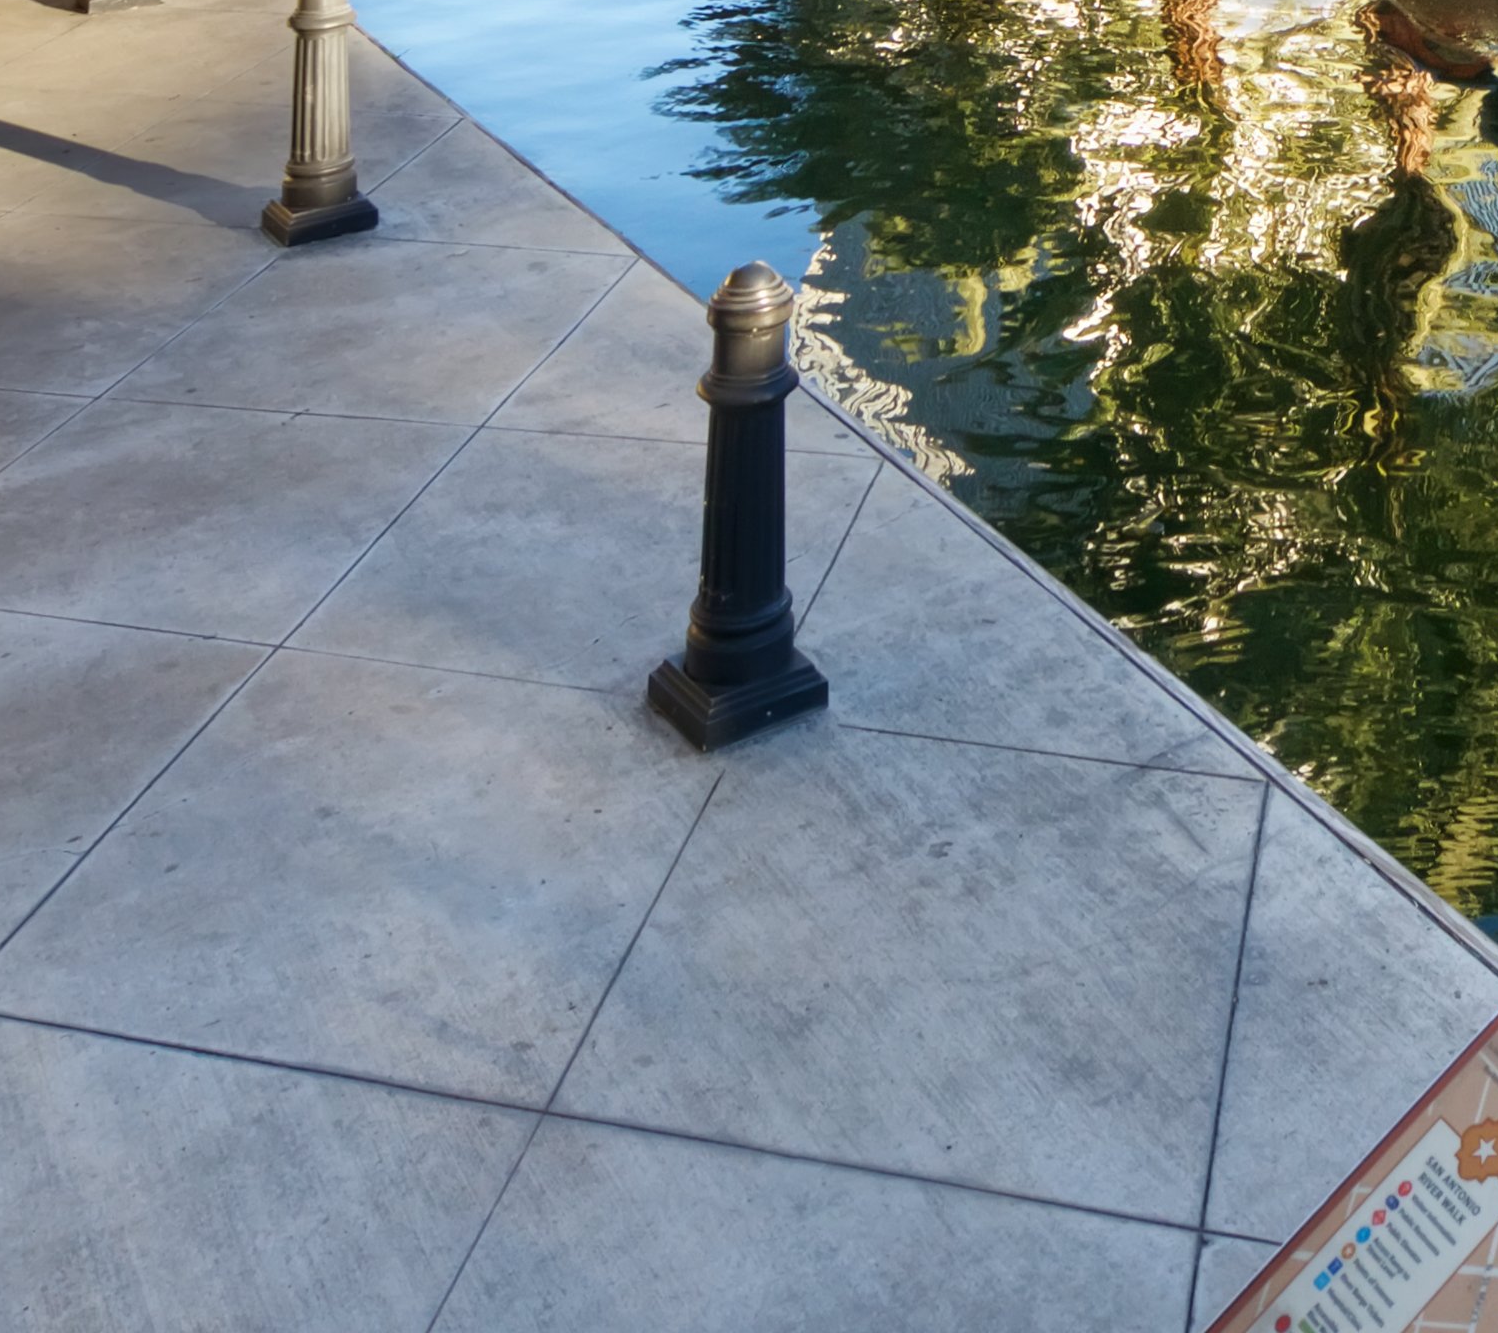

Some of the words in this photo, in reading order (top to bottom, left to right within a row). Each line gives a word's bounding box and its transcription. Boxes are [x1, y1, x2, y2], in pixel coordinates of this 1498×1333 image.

[1418, 1171, 1444, 1201] RIVER
[1441, 1196, 1466, 1225] WALK
[1425, 1156, 1445, 1177] SAN
[1442, 1175, 1481, 1216] ANTONIO
